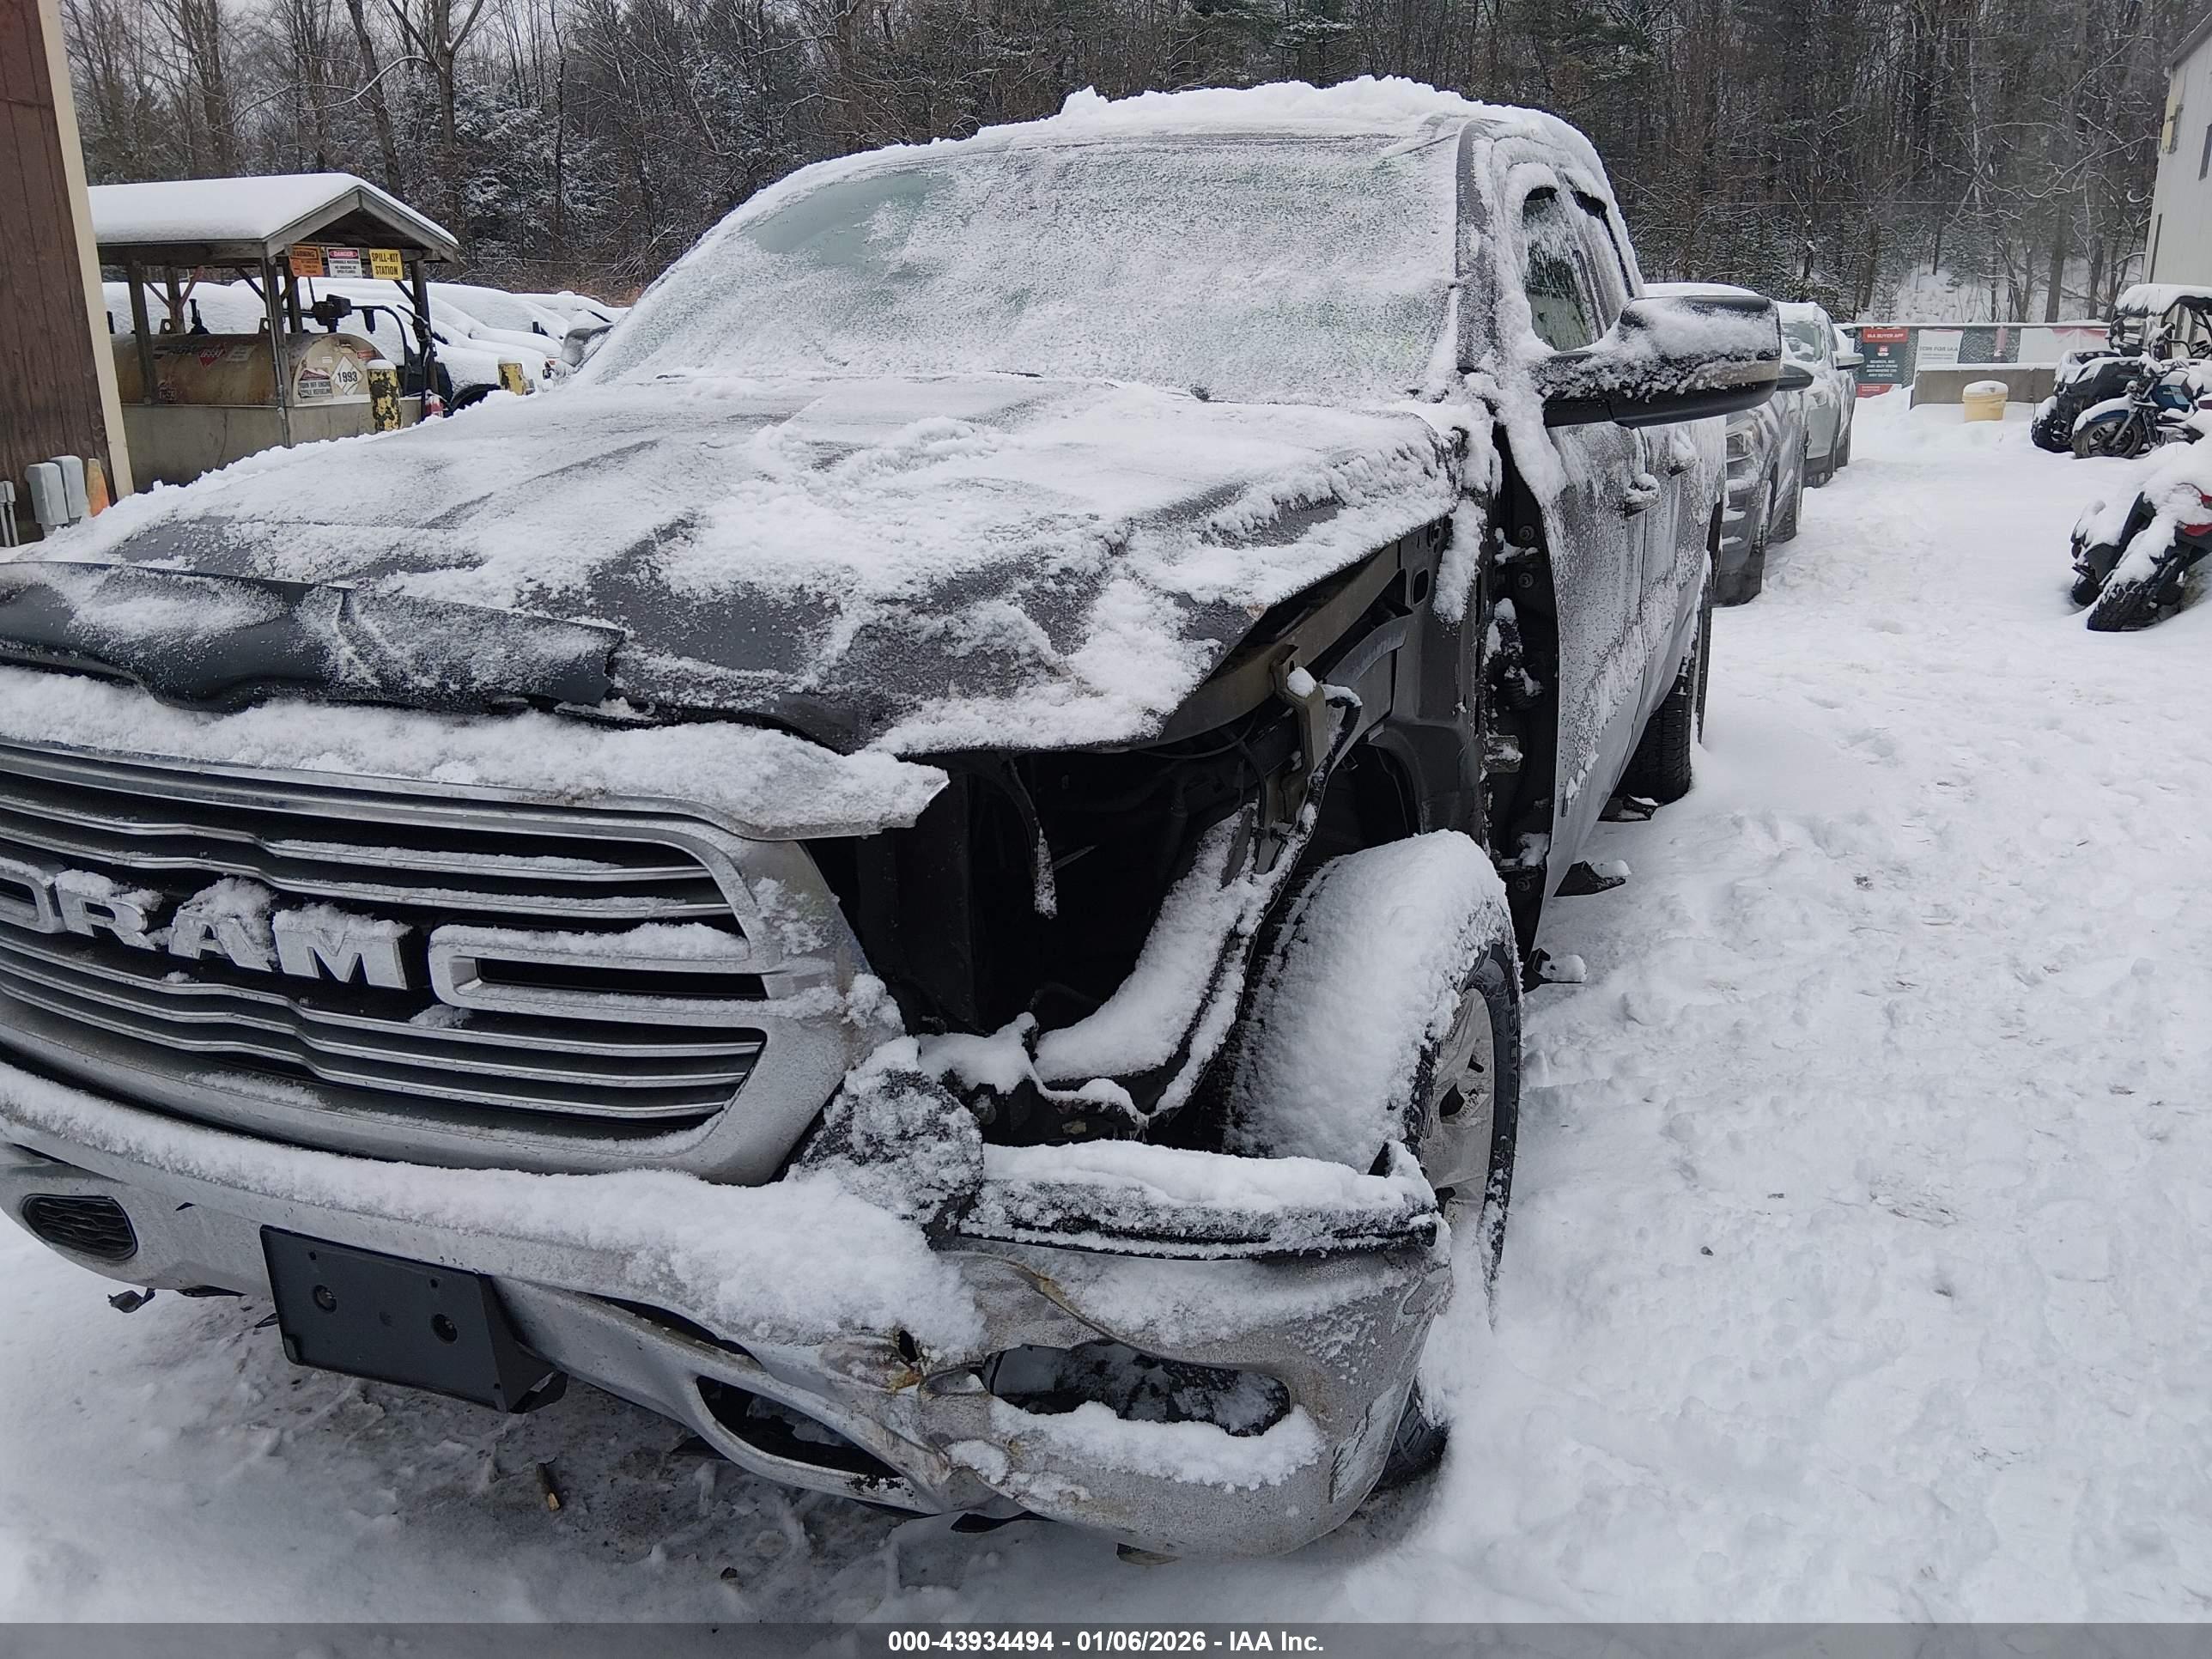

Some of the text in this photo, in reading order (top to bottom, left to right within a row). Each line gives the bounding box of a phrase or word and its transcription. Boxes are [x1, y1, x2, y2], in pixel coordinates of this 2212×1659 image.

[371, 252, 399, 263] SPILL-KIT
[374, 265, 398, 276] STATION
[337, 371, 358, 383] 1993
[55, 884, 410, 991] RAM
